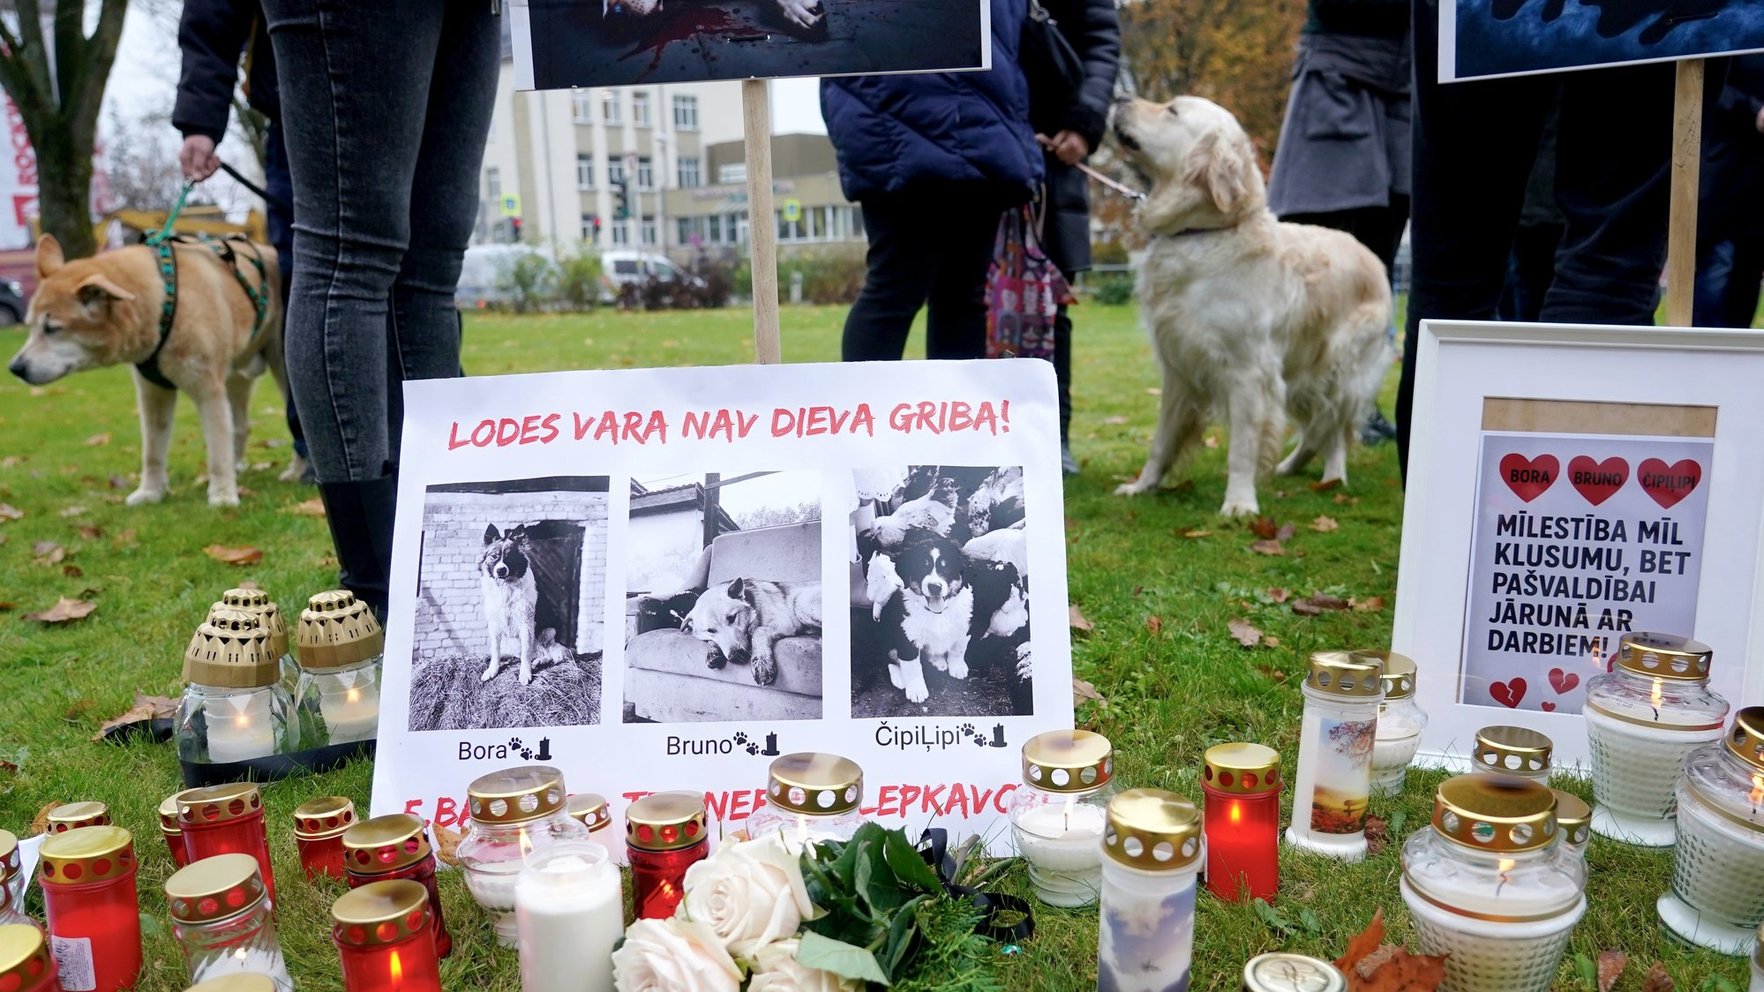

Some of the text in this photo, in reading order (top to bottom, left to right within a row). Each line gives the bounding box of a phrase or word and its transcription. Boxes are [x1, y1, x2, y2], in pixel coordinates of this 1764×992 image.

[448, 400, 1010, 451] LODES VARA NAV DIEVA GRIBA!
[1510, 469, 1550, 484] BORA
[1573, 471, 1622, 487] BRUNO
[1496, 511, 1683, 545] MĪLESTĪBA MĪL
[1494, 542, 1691, 576] KLUSUMU, BET
[1492, 569, 1656, 603] PAŠVALDĪBAI
[1488, 598, 1633, 632] JĀRUNĀ AR
[1487, 629, 1608, 658] DARBIEM!
[458, 741, 508, 761] Bora
[666, 736, 733, 758] Bruno
[875, 721, 962, 752] ČipiĻipi
